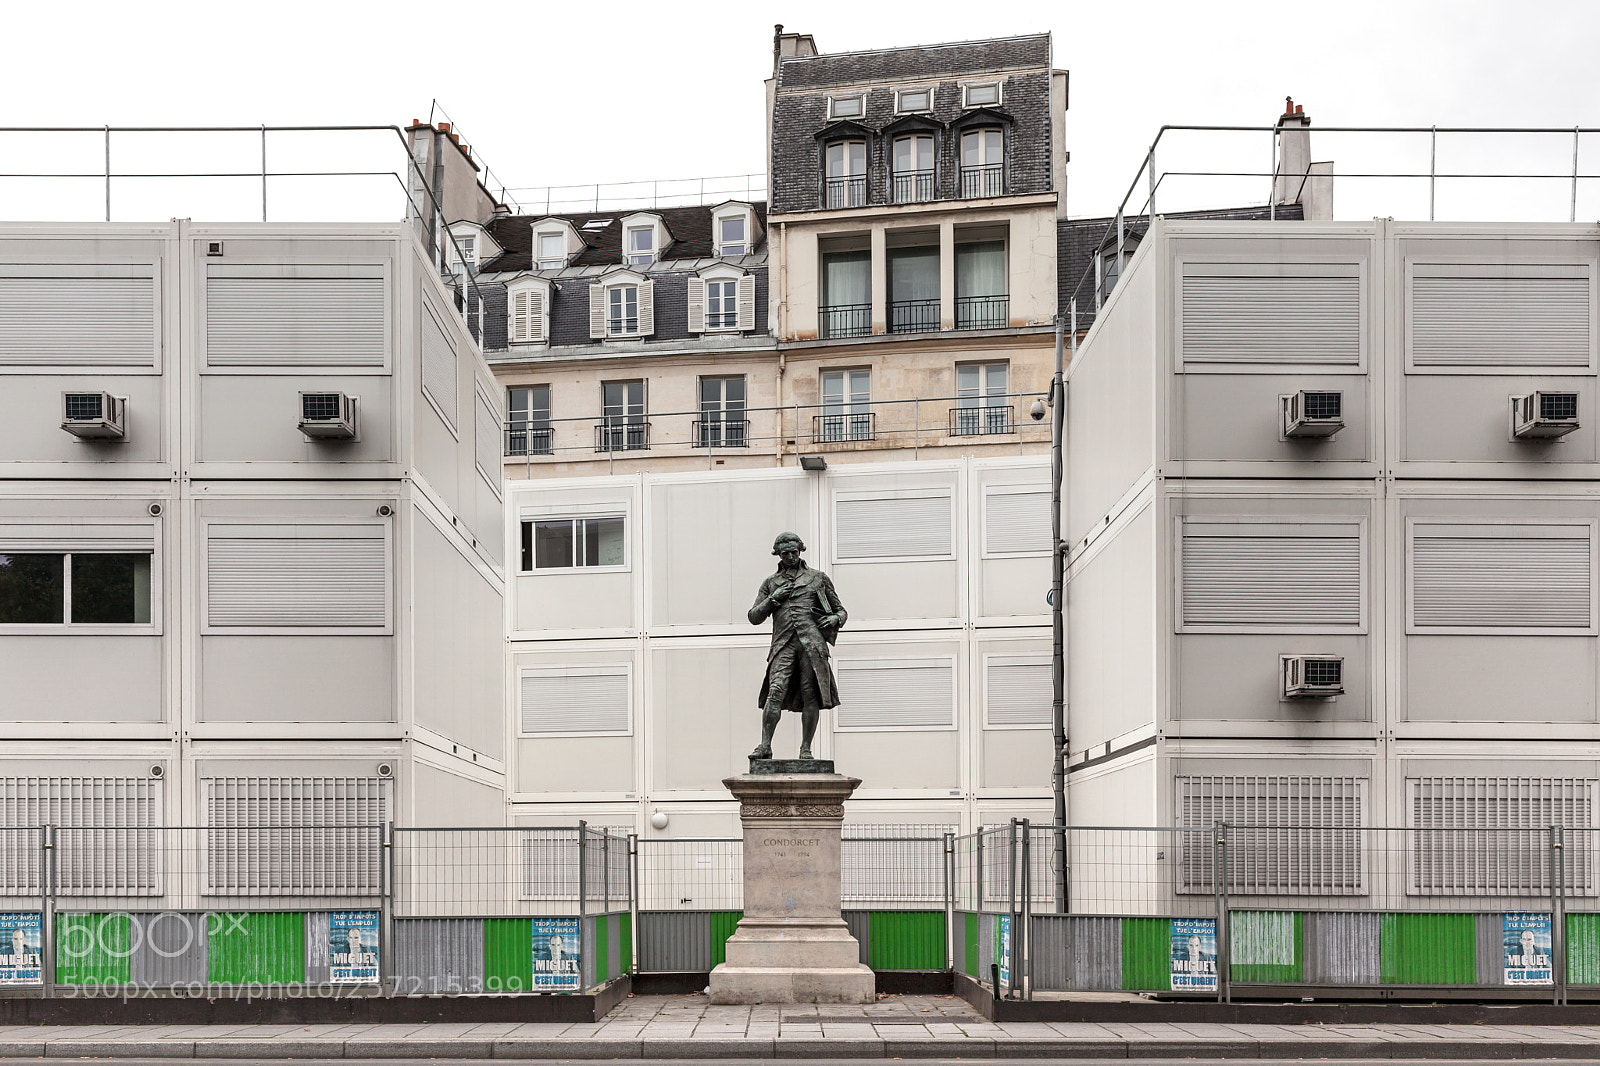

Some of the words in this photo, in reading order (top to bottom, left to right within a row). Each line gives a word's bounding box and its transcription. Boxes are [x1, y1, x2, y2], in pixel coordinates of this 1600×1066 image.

[763, 838, 821, 847] CONDORCET
[333, 952, 376, 964] MIGUET
[1508, 954, 1550, 966] MIGUET
[535, 960, 577, 971] MIGUET
[1173, 959, 1216, 972] MIGUET
